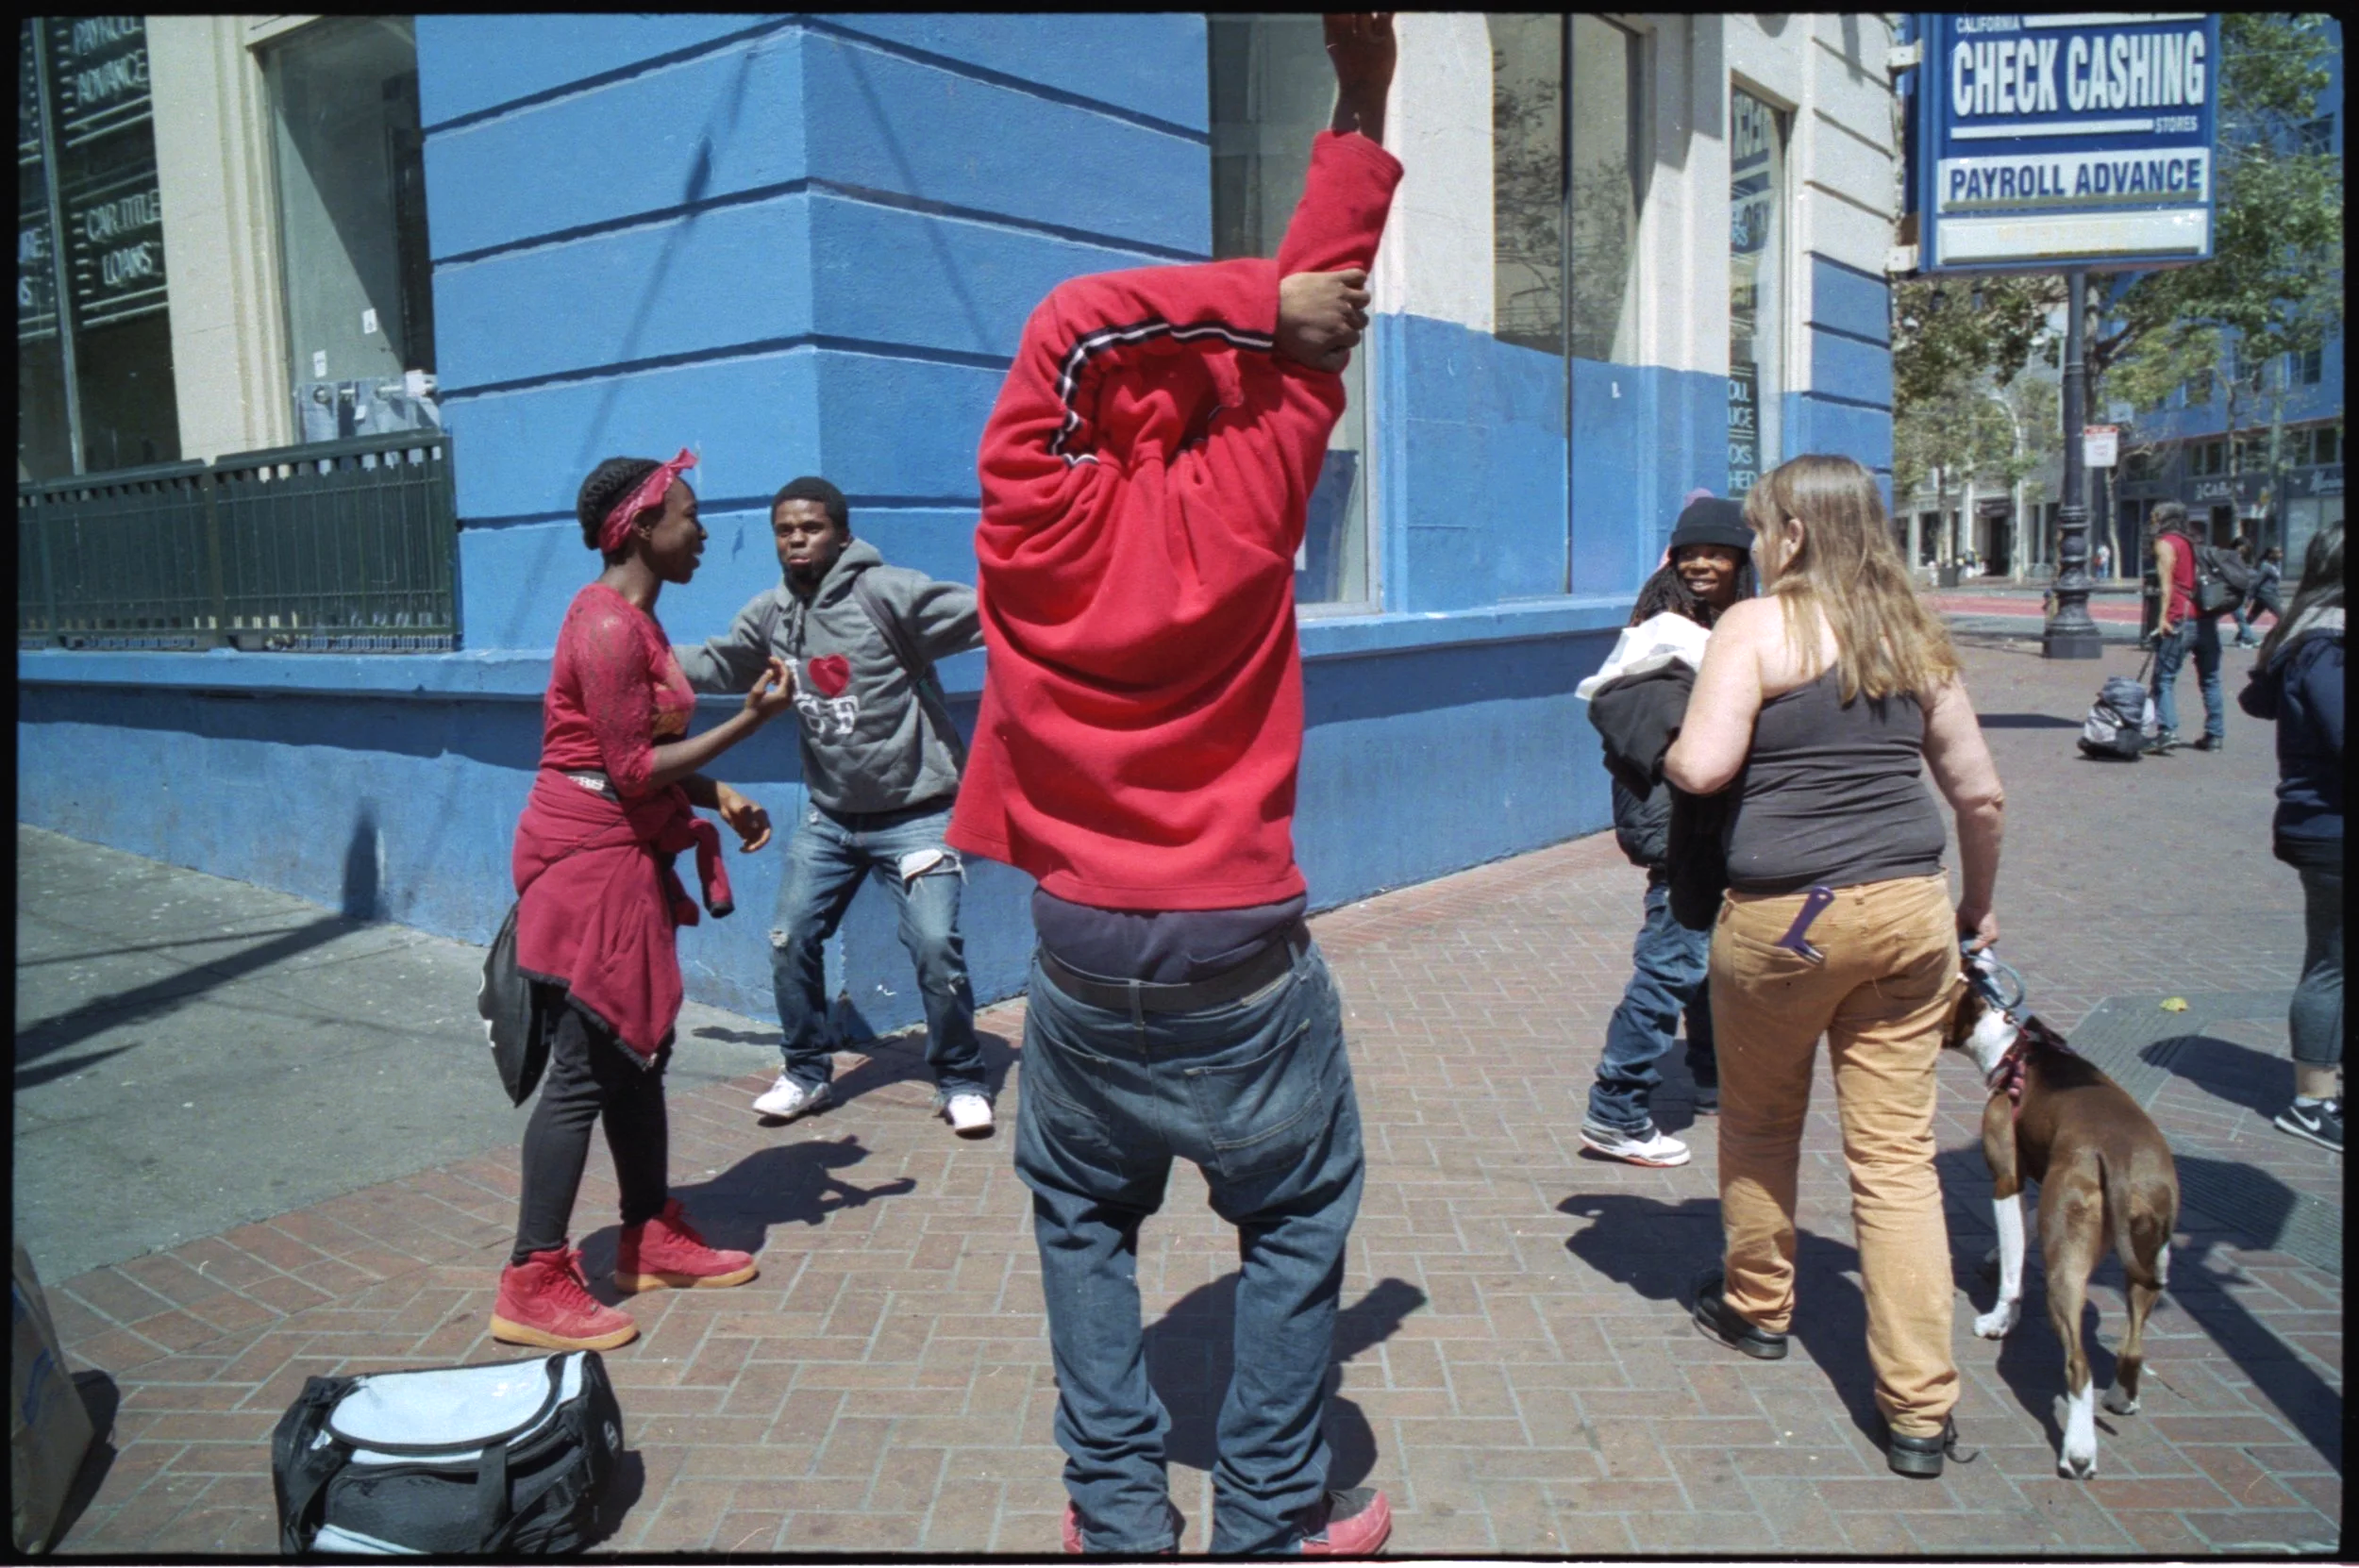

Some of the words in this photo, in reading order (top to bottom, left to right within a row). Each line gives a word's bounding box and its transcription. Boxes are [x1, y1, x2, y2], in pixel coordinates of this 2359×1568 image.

[1955, 14, 2020, 33] CALIFORNIA
[1952, 38, 2059, 116] CHECK
[2066, 30, 2205, 111] CASHING
[2154, 115, 2199, 133] STORES
[1949, 164, 2065, 201] PAYROLL
[2076, 158, 2202, 195] ADVANCE
[86, 203, 121, 244] CAR
[119, 189, 161, 232] TITLE
[101, 242, 152, 287] LOANS
[797, 694, 860, 735] SF
